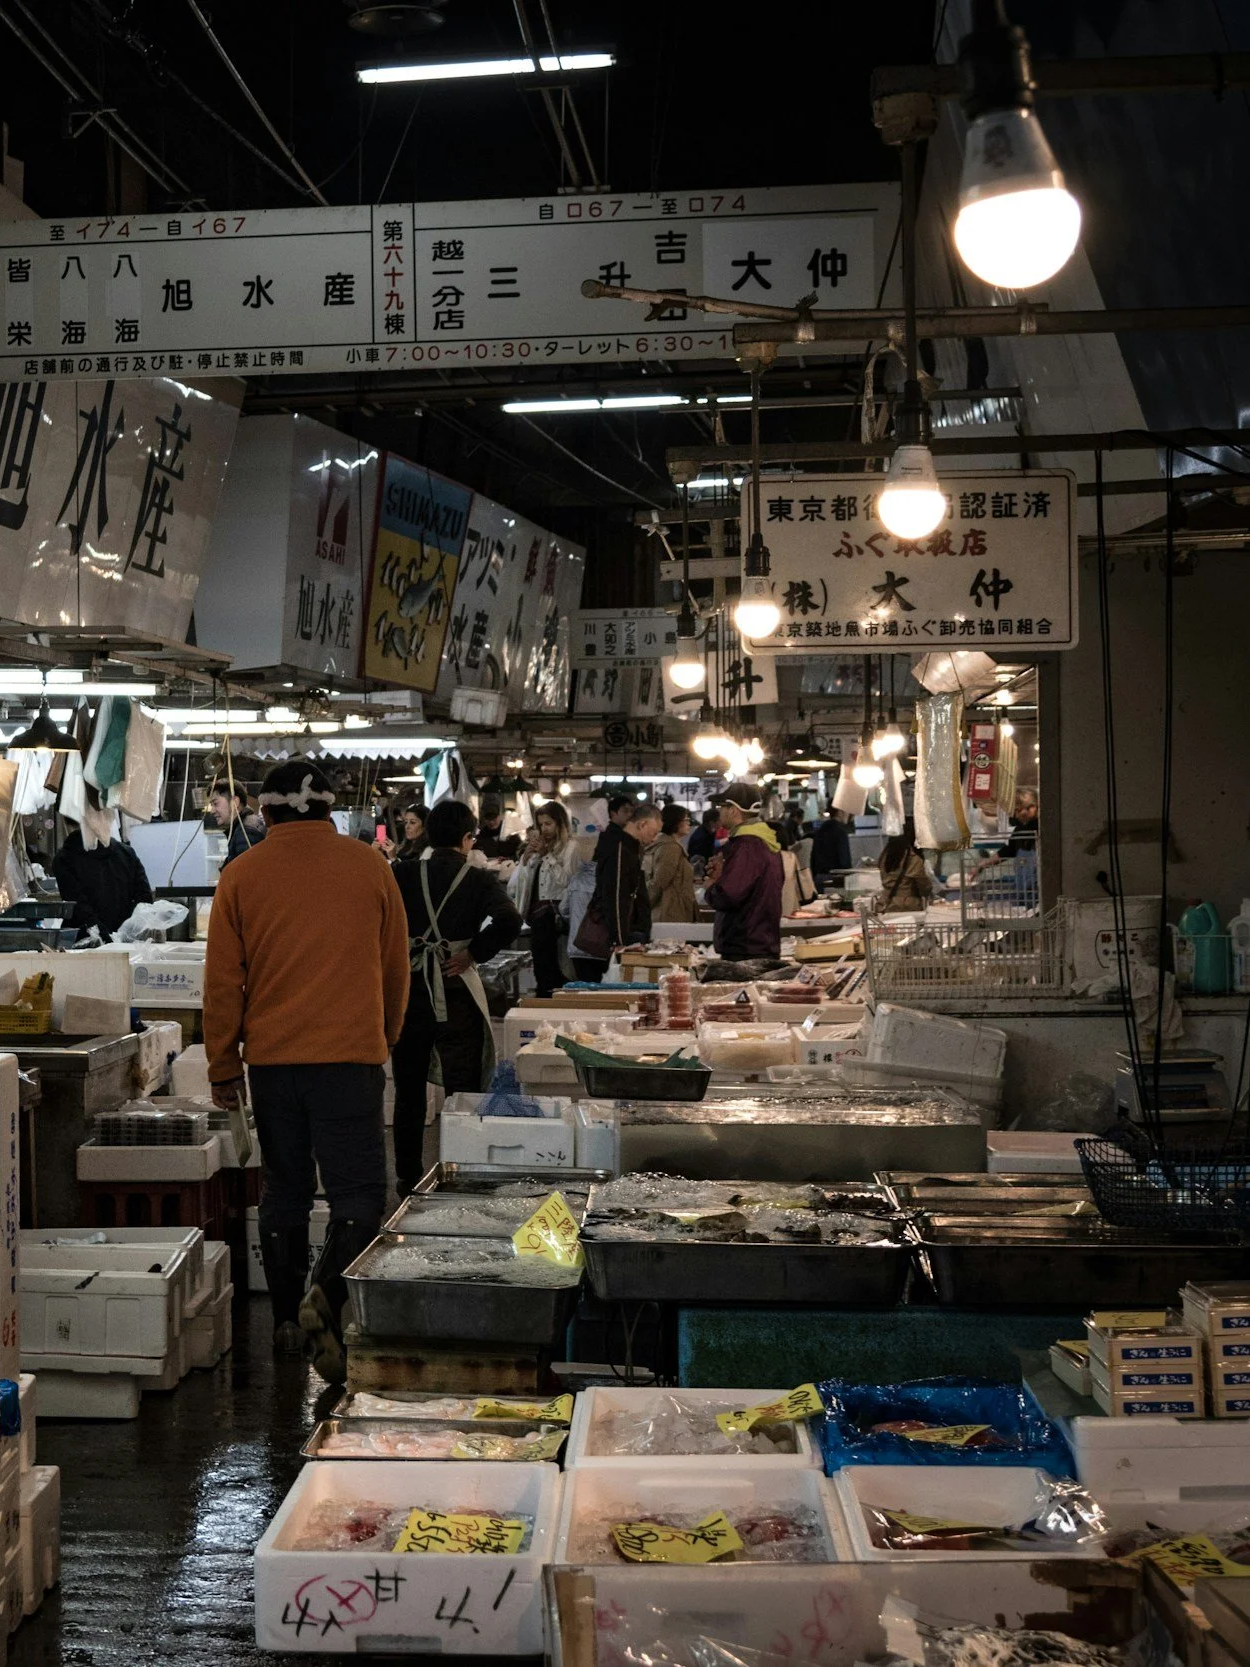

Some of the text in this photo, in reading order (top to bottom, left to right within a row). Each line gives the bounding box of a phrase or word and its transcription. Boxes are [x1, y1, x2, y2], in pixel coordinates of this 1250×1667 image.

[7, 257, 33, 347] 皆栄
[61, 255, 87, 345] 八海
[113, 254, 140, 344] 八海
[162, 272, 355, 312] 旭水産
[383, 220, 406, 335] 第六十九棟
[432, 239, 465, 331] 越一分店
[731, 248, 848, 291] 大仲
[385, 481, 464, 541] SHIMAZU
[766, 491, 1051, 522] 東京都認証済
[315, 539, 347, 566] ASAHI
[294, 573, 355, 650] 旭水産
[869, 567, 1013, 612] 大仲
